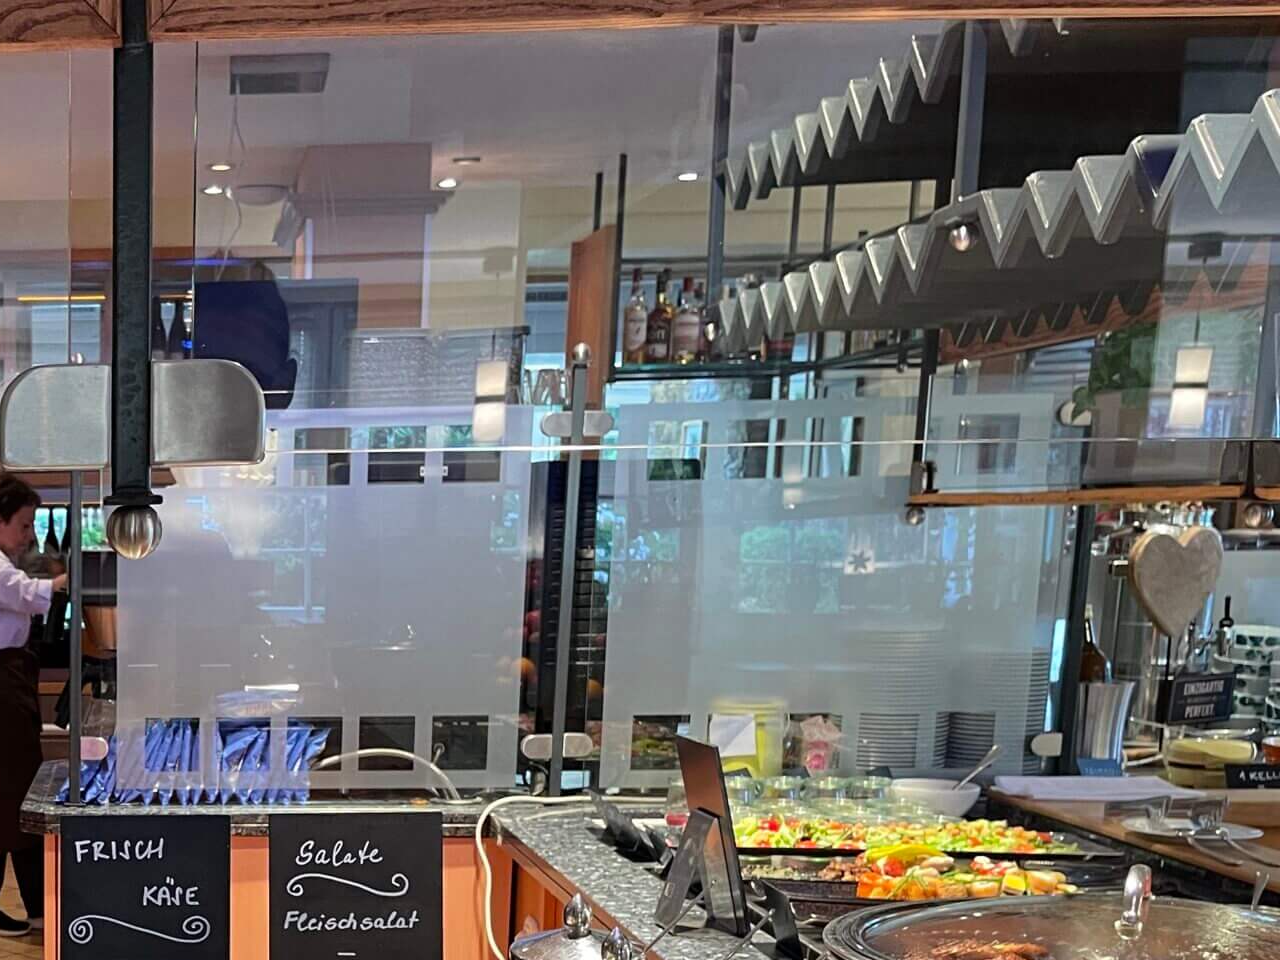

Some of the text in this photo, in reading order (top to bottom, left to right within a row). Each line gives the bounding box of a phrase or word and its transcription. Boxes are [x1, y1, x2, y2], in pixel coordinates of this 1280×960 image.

[1249, 770, 1280, 780] KELL
[74, 838, 164, 863] FRISCH
[295, 840, 383, 867] Salate
[142, 876, 200, 906] KÄSE
[283, 910, 419, 931] Fleischsalat
